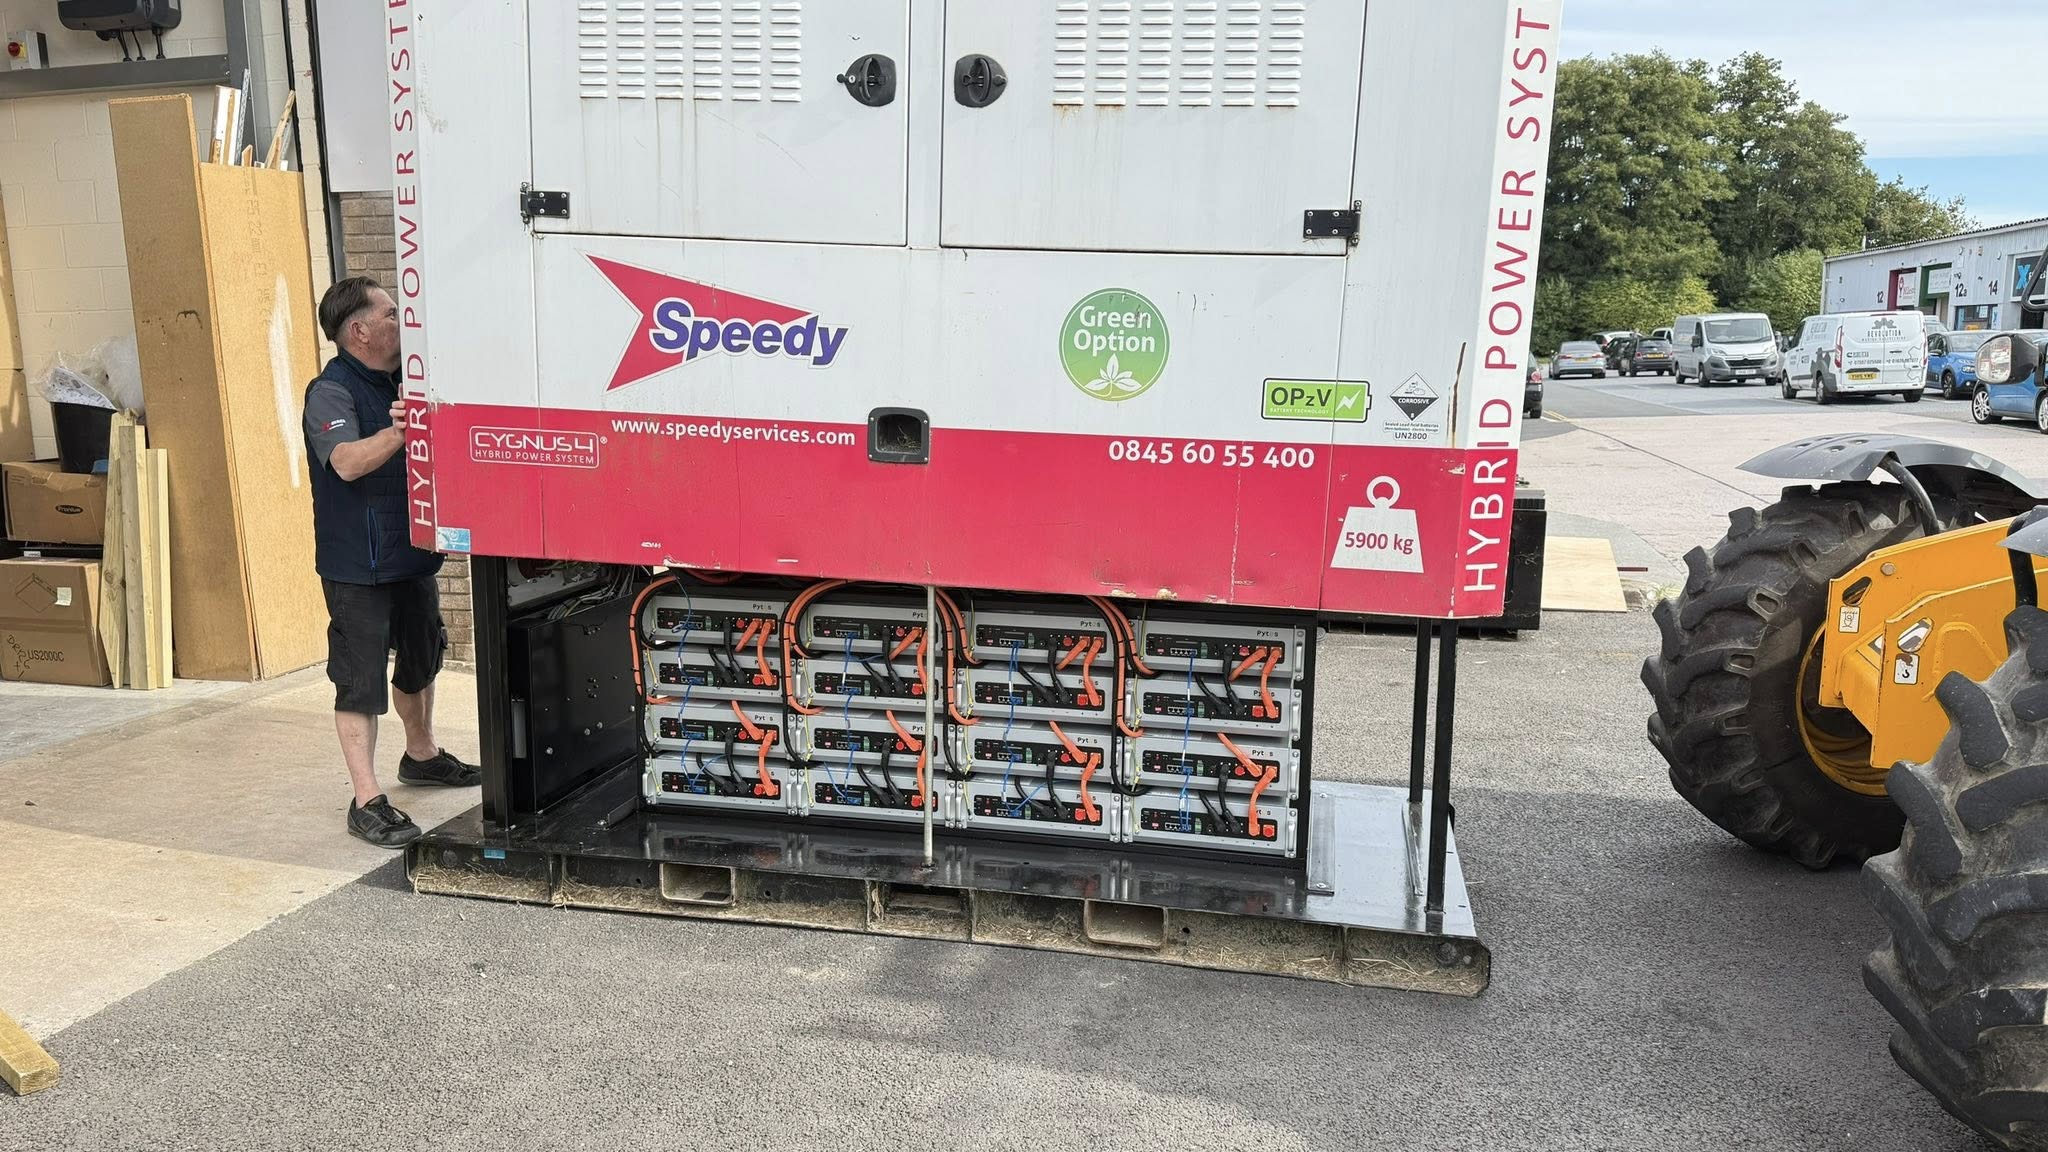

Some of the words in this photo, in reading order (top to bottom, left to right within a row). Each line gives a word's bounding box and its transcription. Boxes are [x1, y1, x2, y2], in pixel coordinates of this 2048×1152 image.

[396, 150, 422, 328] POWER
[1484, 169, 1536, 369] POWER
[1877, 291, 1884, 303] 12
[1988, 280, 1998, 296] 14
[1079, 305, 1151, 329] Green
[652, 301, 849, 366] Speedy
[1073, 329, 1155, 357] Option
[1271, 387, 1332, 407] OPzV
[407, 354, 433, 528] HYBRID
[611, 418, 856, 445] www.speedyservices.com
[1394, 432, 1428, 440] UN2800
[475, 449, 512, 459] HYBRID
[516, 451, 551, 461] POWER
[555, 453, 594, 464] SYSTEM
[1108, 440, 1173, 464] 0845
[1182, 442, 1215, 464] 60
[1222, 445, 1254, 467] 55
[1262, 447, 1315, 468] 400
[1463, 398, 1512, 592] HYBRID
[1344, 531, 1388, 549] 5900
[1393, 533, 1414, 555] kg
